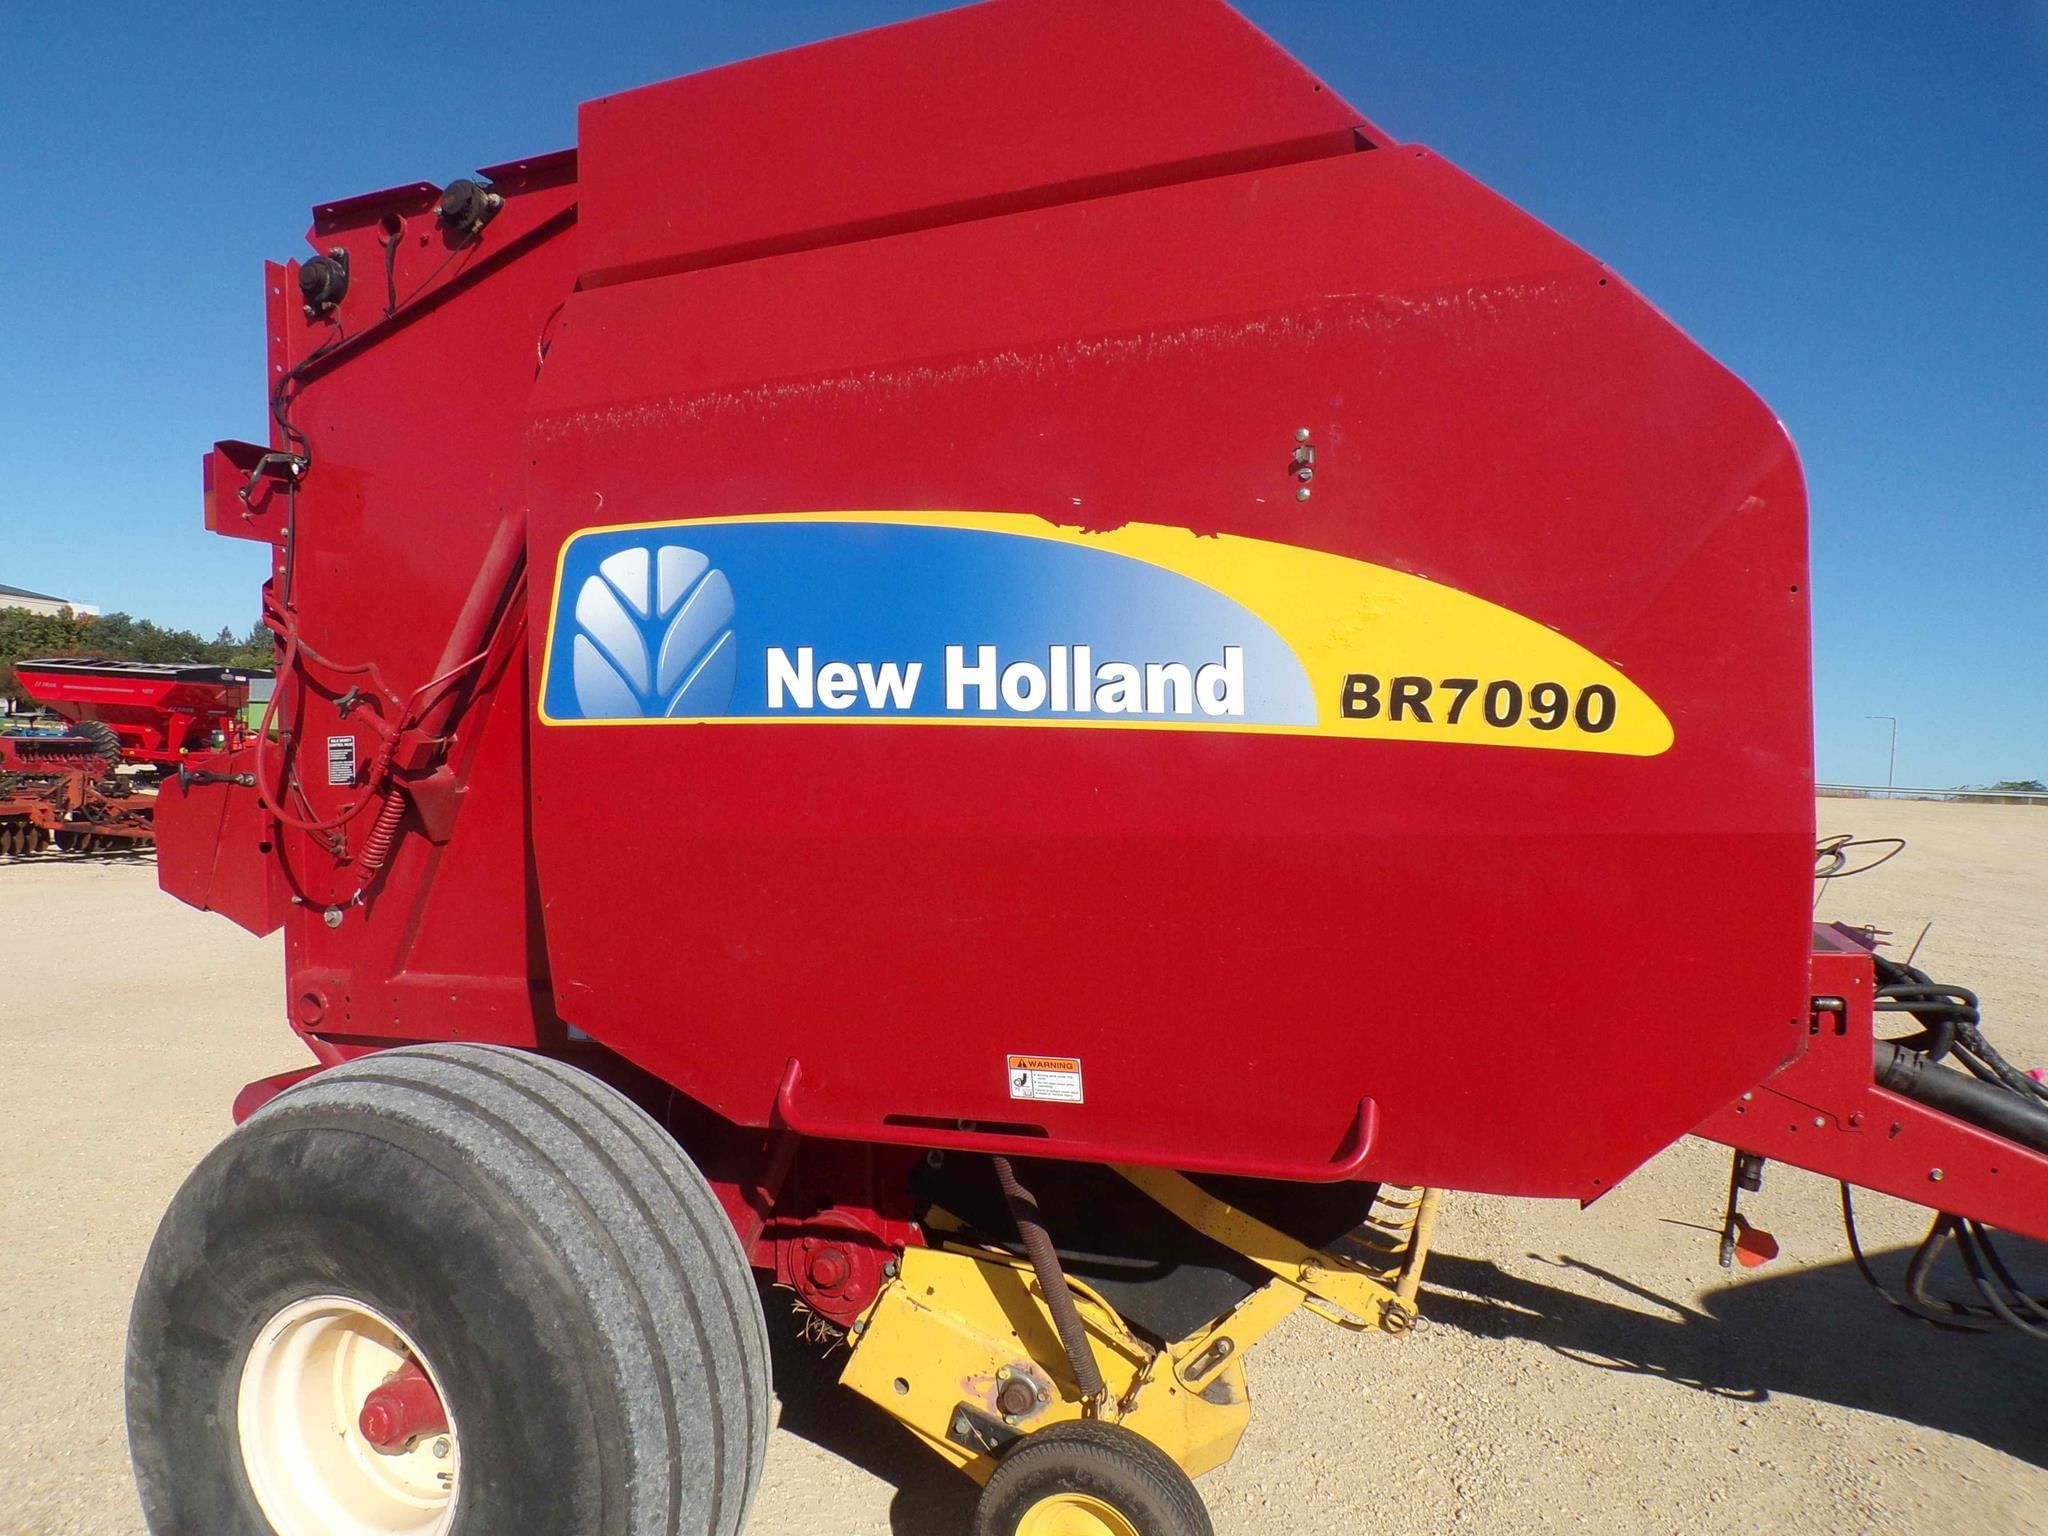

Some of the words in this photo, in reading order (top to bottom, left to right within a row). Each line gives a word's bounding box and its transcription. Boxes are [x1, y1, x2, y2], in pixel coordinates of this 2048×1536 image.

[766, 645, 922, 710] New
[944, 644, 1246, 717] Holland
[1340, 673, 1617, 734] BR7090
[1028, 1059, 1074, 1070] WARNING
